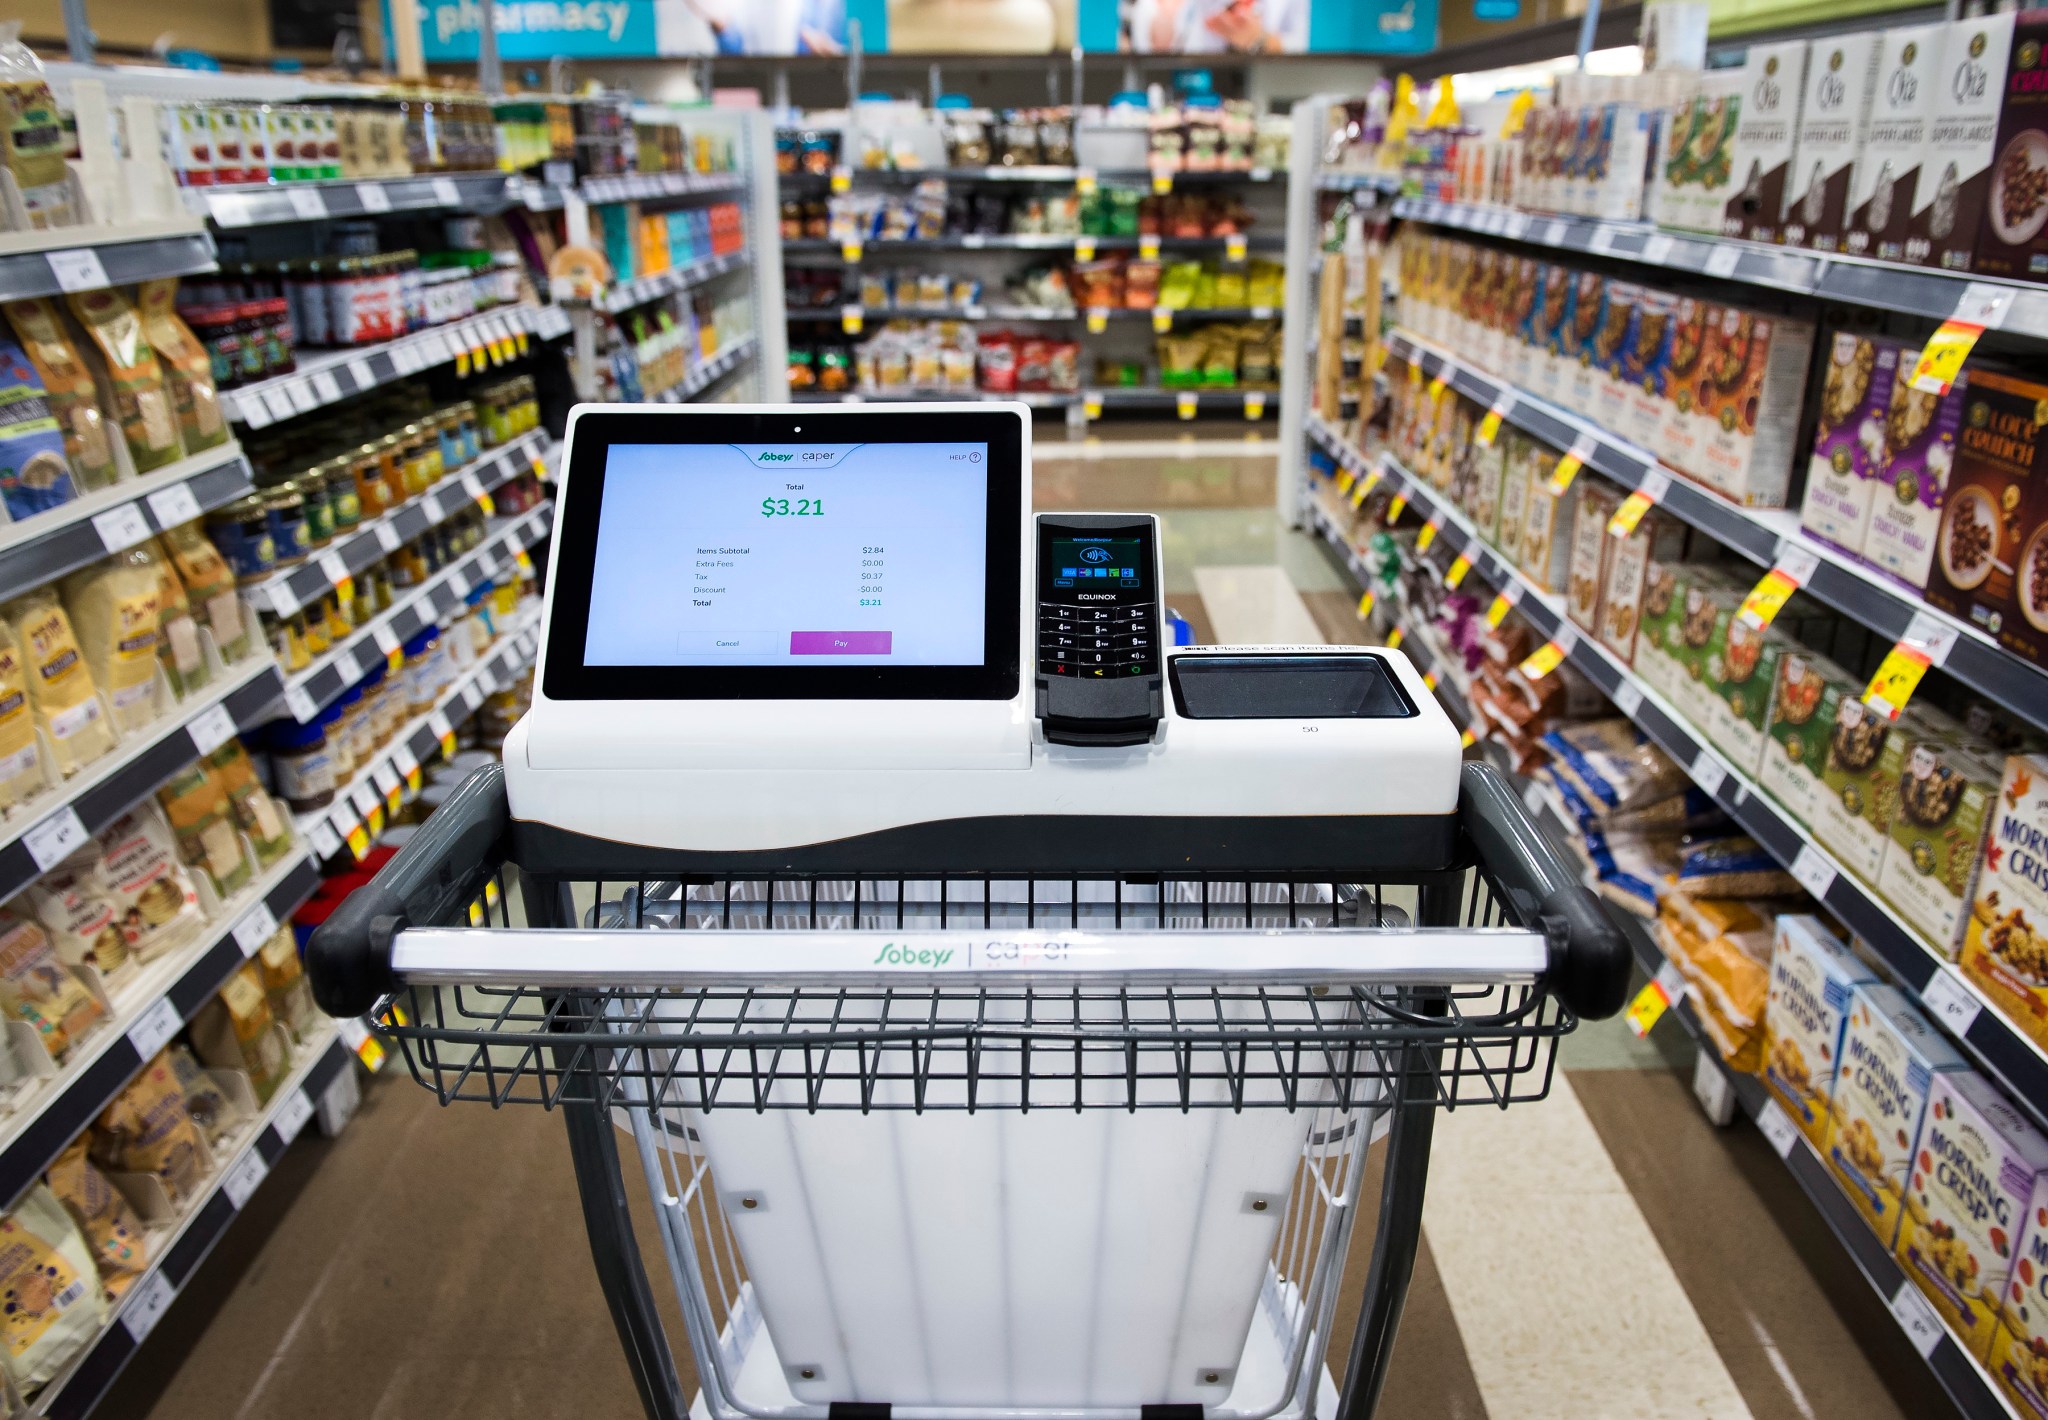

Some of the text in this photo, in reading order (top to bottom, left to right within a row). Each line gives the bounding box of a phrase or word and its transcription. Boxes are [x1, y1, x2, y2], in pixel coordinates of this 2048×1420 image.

[758, 451, 834, 462] Sobeys caper
[761, 497, 825, 518] $3.21
[859, 598, 882, 606] $3.21
[834, 640, 848, 648] Pay
[874, 943, 954, 968] Sobeys
[1851, 1036, 1911, 1121] MORNING
[1854, 1068, 1896, 1118] CRISP
[1930, 1126, 2011, 1229] MORNING
[1937, 1162, 1989, 1221] CRISP
